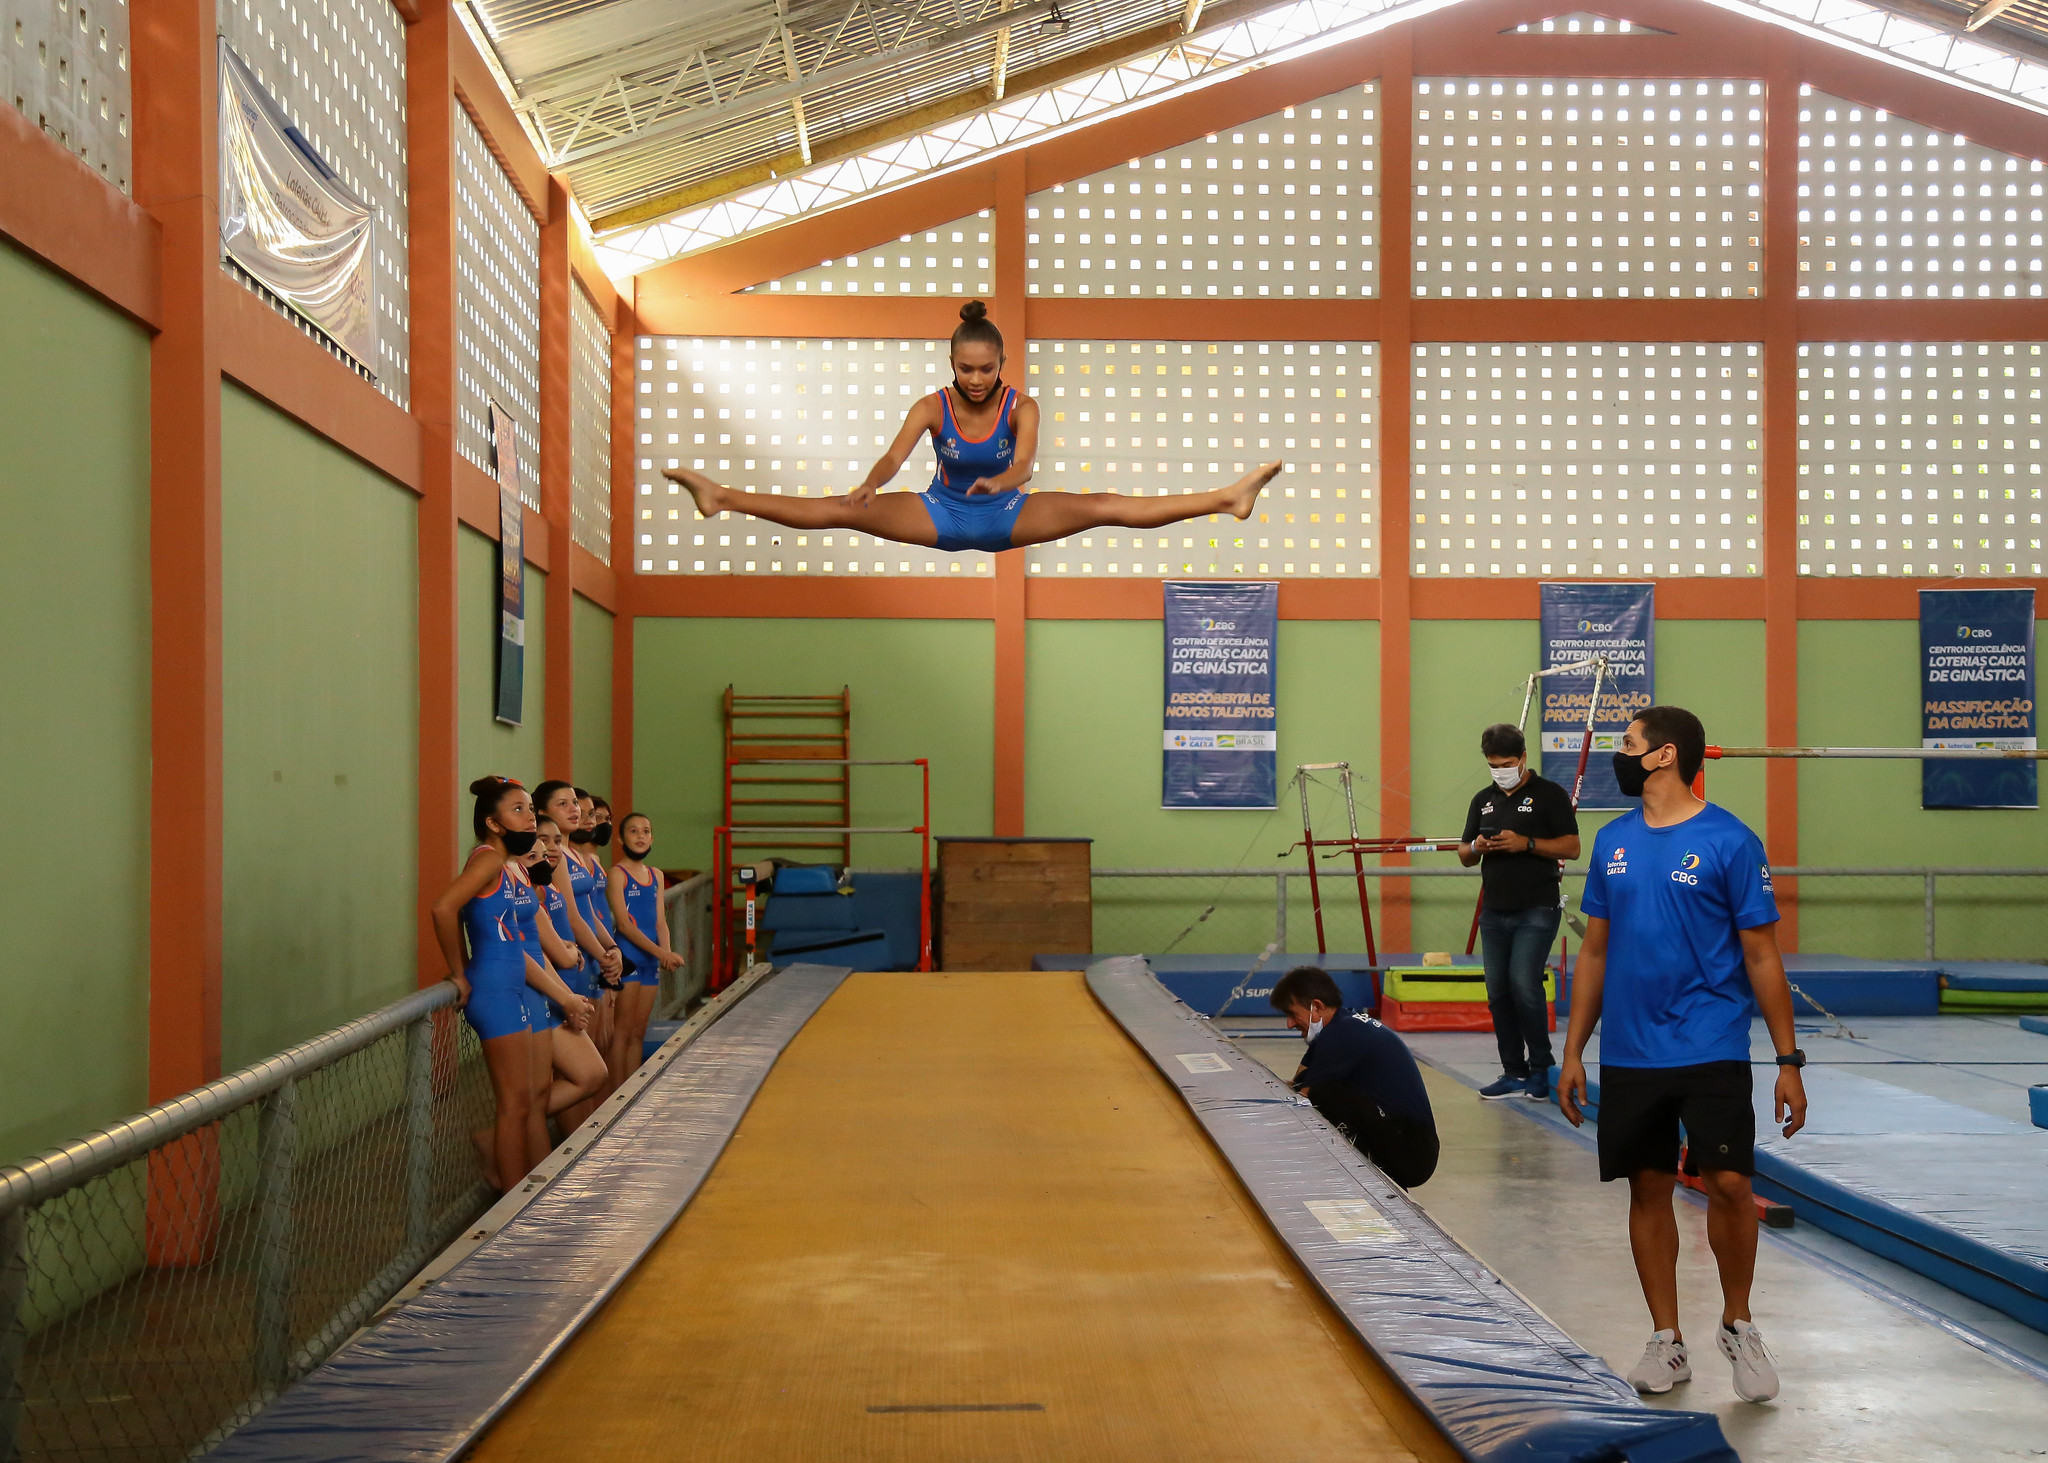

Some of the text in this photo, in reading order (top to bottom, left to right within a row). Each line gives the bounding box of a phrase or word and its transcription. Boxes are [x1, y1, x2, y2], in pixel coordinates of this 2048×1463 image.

[1215, 621, 1236, 630] CBG
[1591, 623, 1613, 632] CBG
[1971, 629, 1992, 638] CBG
[1172, 637, 1207, 645] CENTRO
[1219, 637, 1269, 646] EXCELÊNCIA
[1549, 639, 1583, 648] CENTRO
[1595, 638, 1646, 648] EXCELÊNCIA
[1172, 648, 1268, 659] LOTERIAS CAIXA
[1928, 646, 1963, 654] CENTRO
[1975, 644, 2026, 653] EXCELÊNCIA
[1608, 650, 1646, 661] CAIXA
[1929, 655, 2026, 667] LOTERIAS CAIXA
[1172, 659, 1268, 674] DE GINÁSTICA
[1929, 667, 2026, 682] DE GINÁSTICA
[1170, 693, 1271, 704] DESCOBERTA DE
[1925, 697, 2033, 715] MASSIFICAÇÃO
[1166, 706, 1275, 718] NOVOS TALENTOS
[1928, 713, 2029, 729] DA GINÁSTICA
[1236, 738, 1265, 746] BRASIL
[1517, 805, 1533, 813] CBG
[1607, 859, 1628, 869] loterias
[1606, 866, 1626, 876] CAIXA
[1671, 870, 1699, 886] CBG
